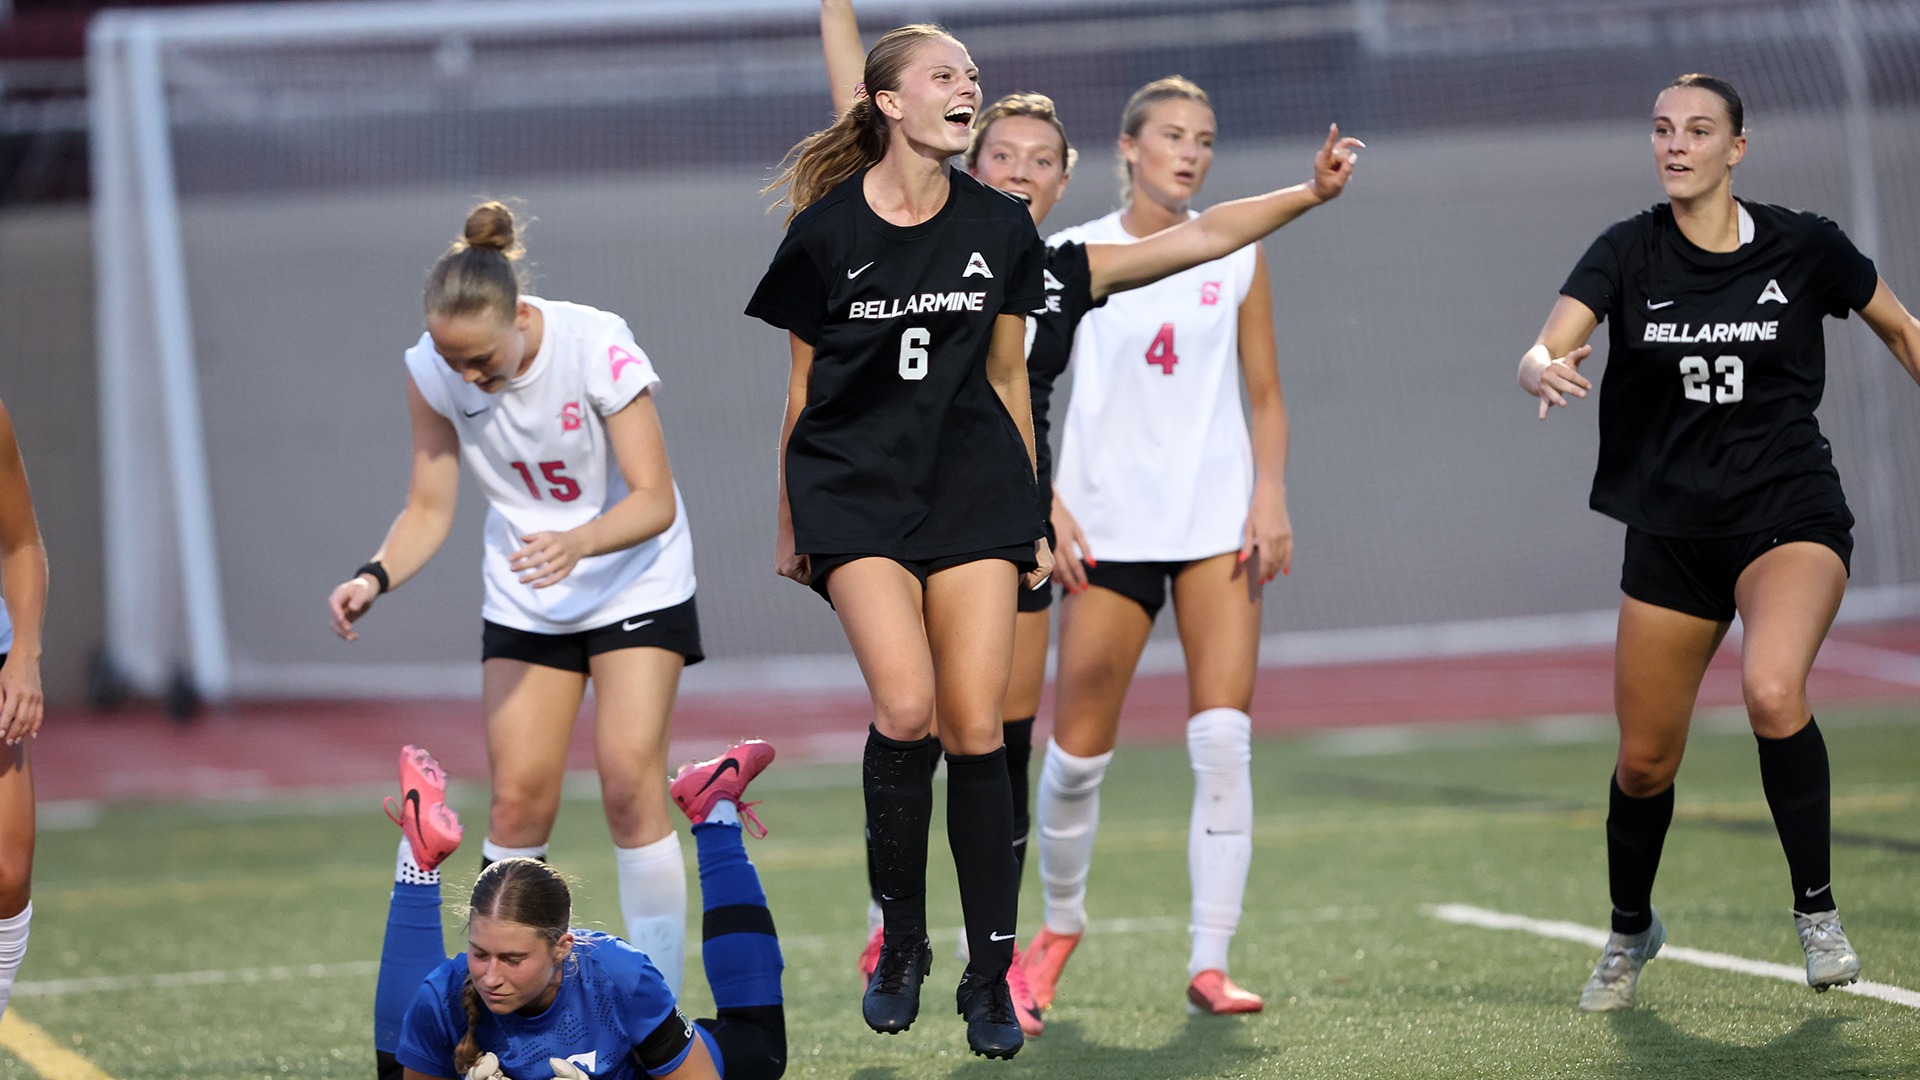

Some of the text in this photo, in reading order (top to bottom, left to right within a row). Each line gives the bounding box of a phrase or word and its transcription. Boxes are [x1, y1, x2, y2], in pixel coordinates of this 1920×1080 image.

[848, 291, 987, 320] BELLARMINE
[898, 327, 931, 381] 6
[1145, 323, 1178, 375] 4
[1643, 320, 1779, 343] BELLARMINE
[1679, 355, 1744, 405] 23
[510, 460, 582, 502] 15
